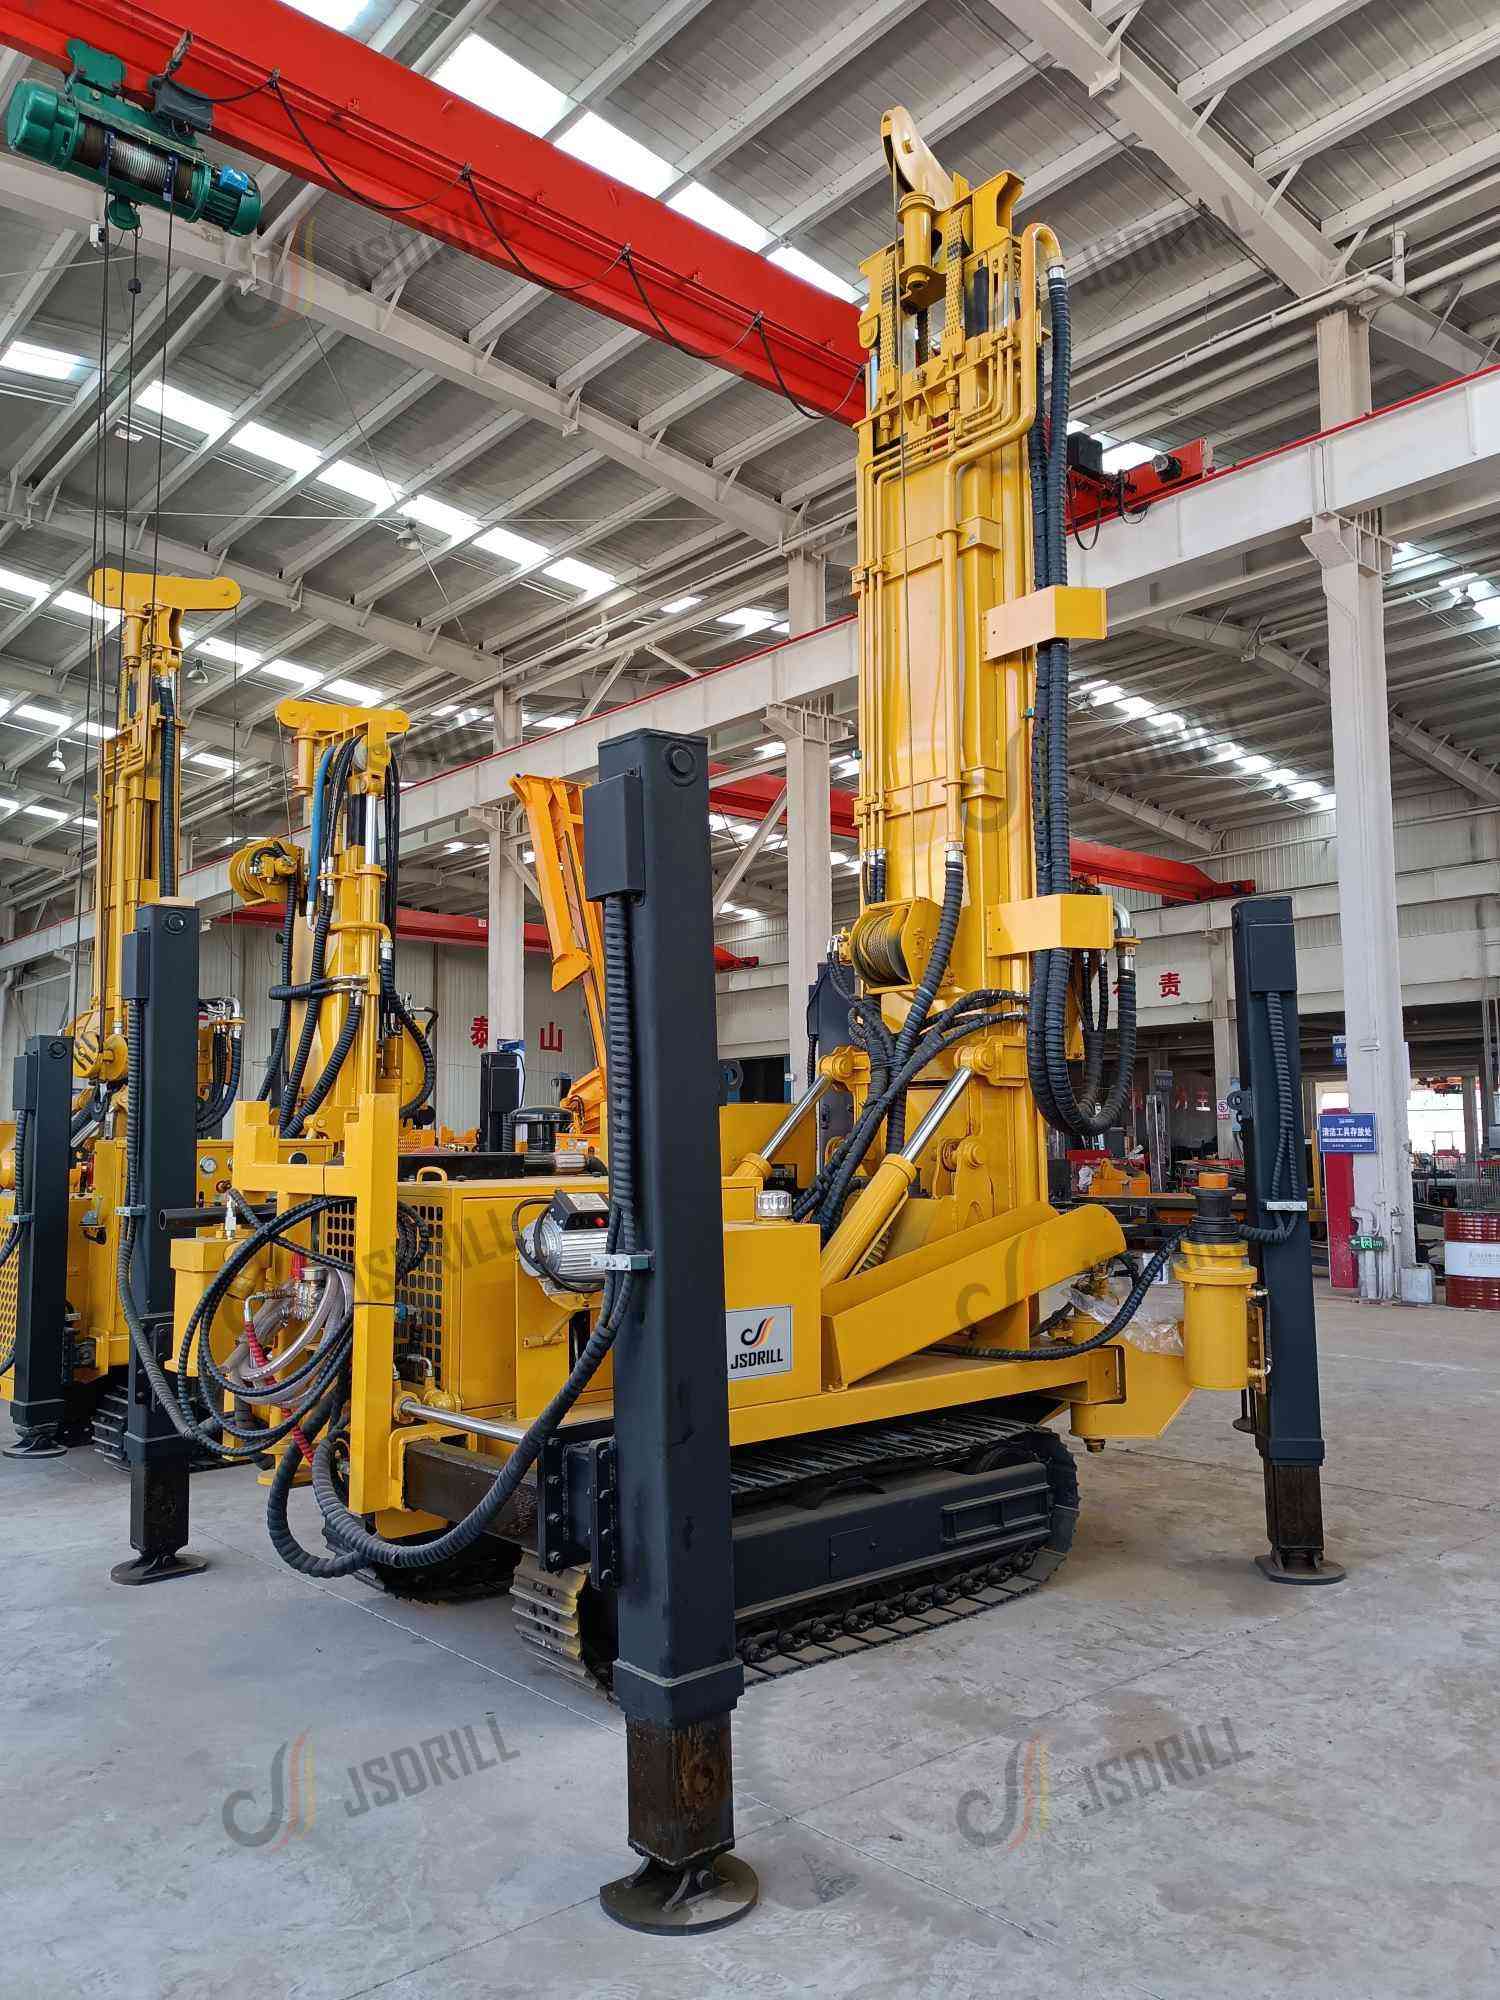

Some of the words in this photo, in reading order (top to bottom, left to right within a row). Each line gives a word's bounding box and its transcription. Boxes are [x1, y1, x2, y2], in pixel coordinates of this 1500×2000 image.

[1158, 972, 1181, 998] 责
[539, 1022, 563, 1052] 山
[1322, 1126, 1372, 1137] 清洁工具存放处
[730, 1348, 784, 1370] JSDRILL
